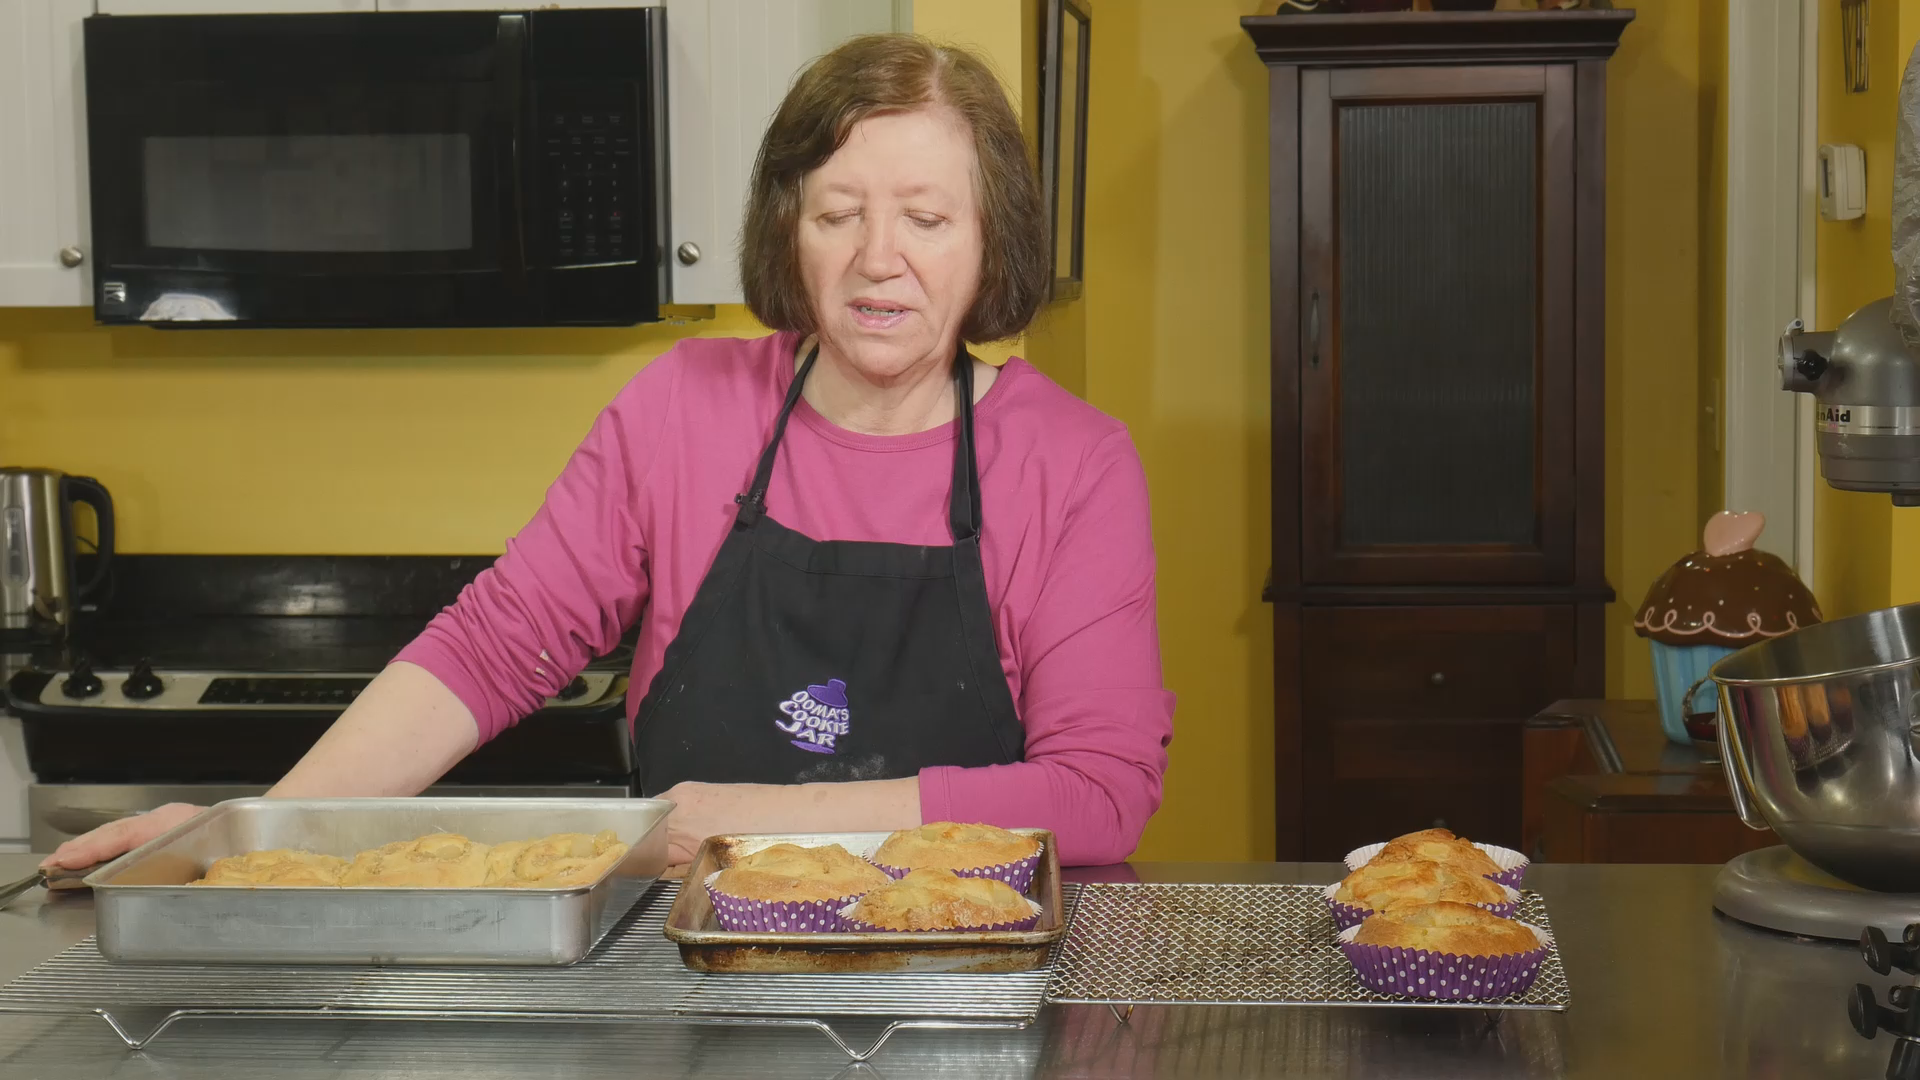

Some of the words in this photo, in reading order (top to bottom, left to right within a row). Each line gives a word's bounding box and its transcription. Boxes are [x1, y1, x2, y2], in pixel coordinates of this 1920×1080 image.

[780, 701, 849, 735] COOKIE
[792, 691, 849, 721] OOMA'S
[775, 720, 835, 748] JAR
